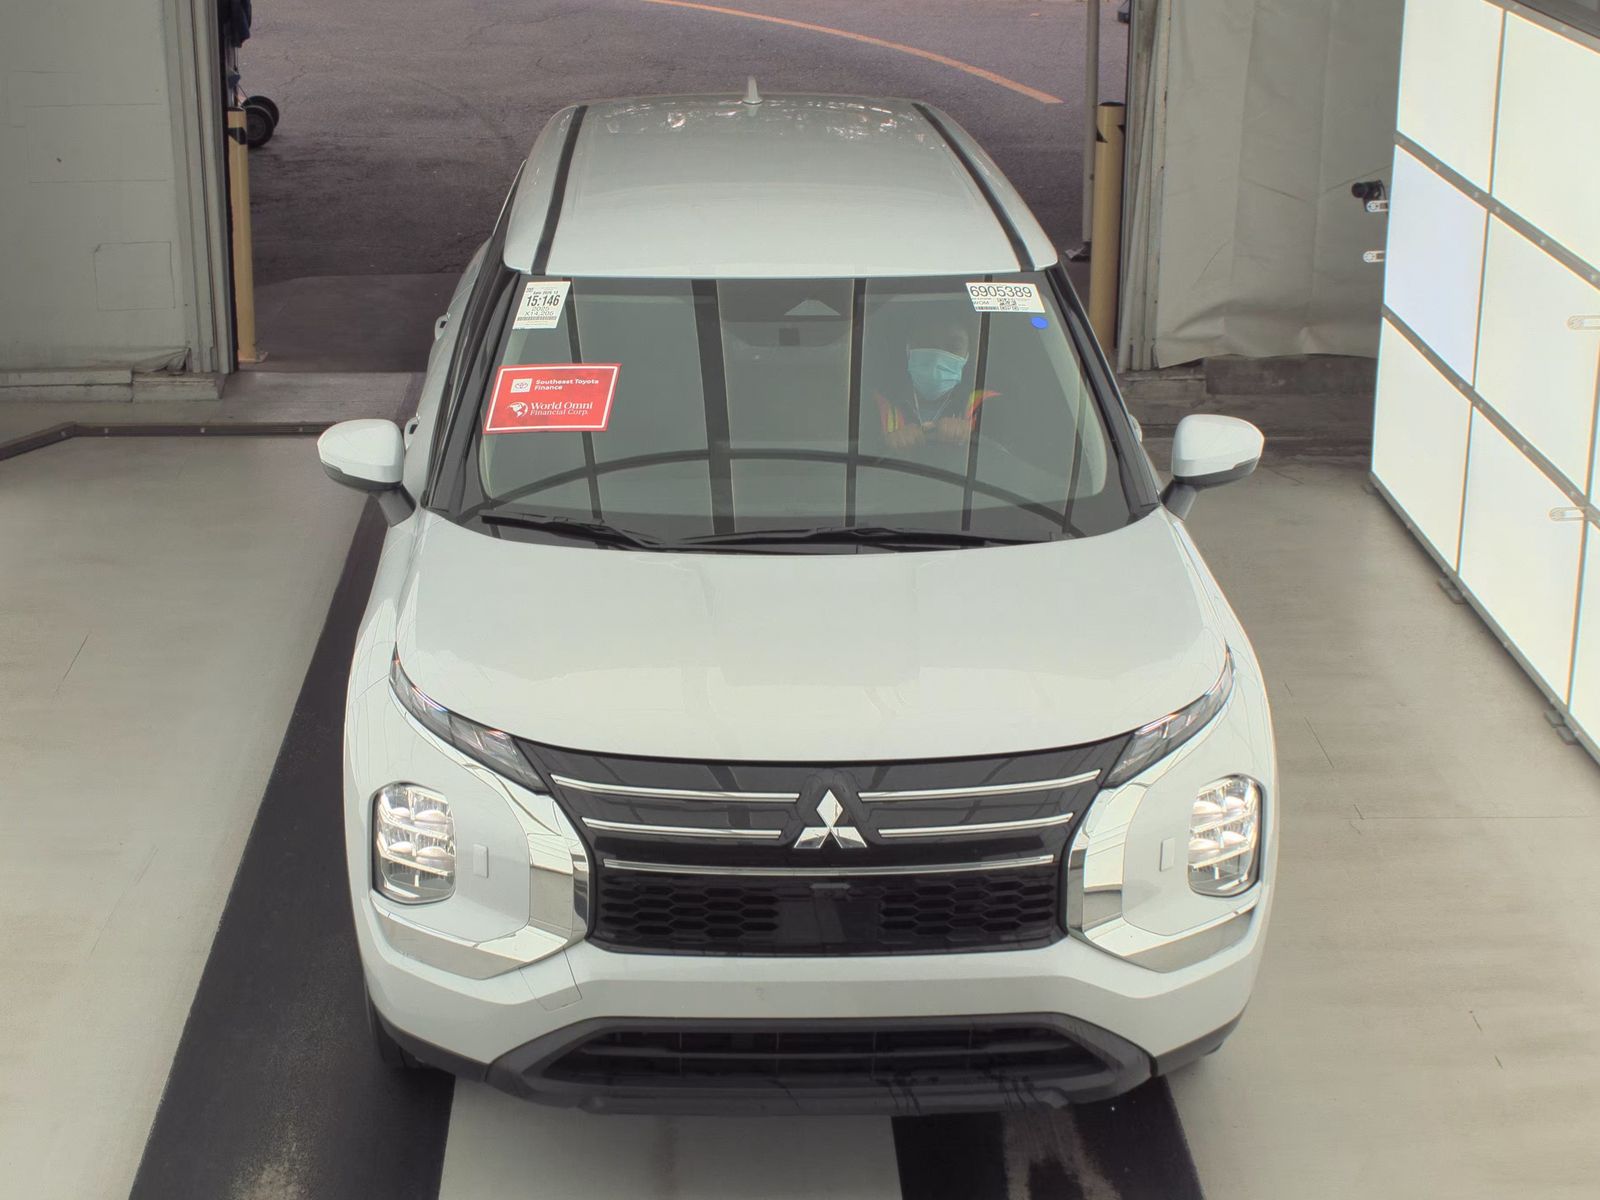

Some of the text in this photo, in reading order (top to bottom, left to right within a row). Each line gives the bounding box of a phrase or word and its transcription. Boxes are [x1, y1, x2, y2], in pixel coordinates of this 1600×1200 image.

[969, 285, 1032, 298] 6905389
[530, 401, 593, 410] World Omni
